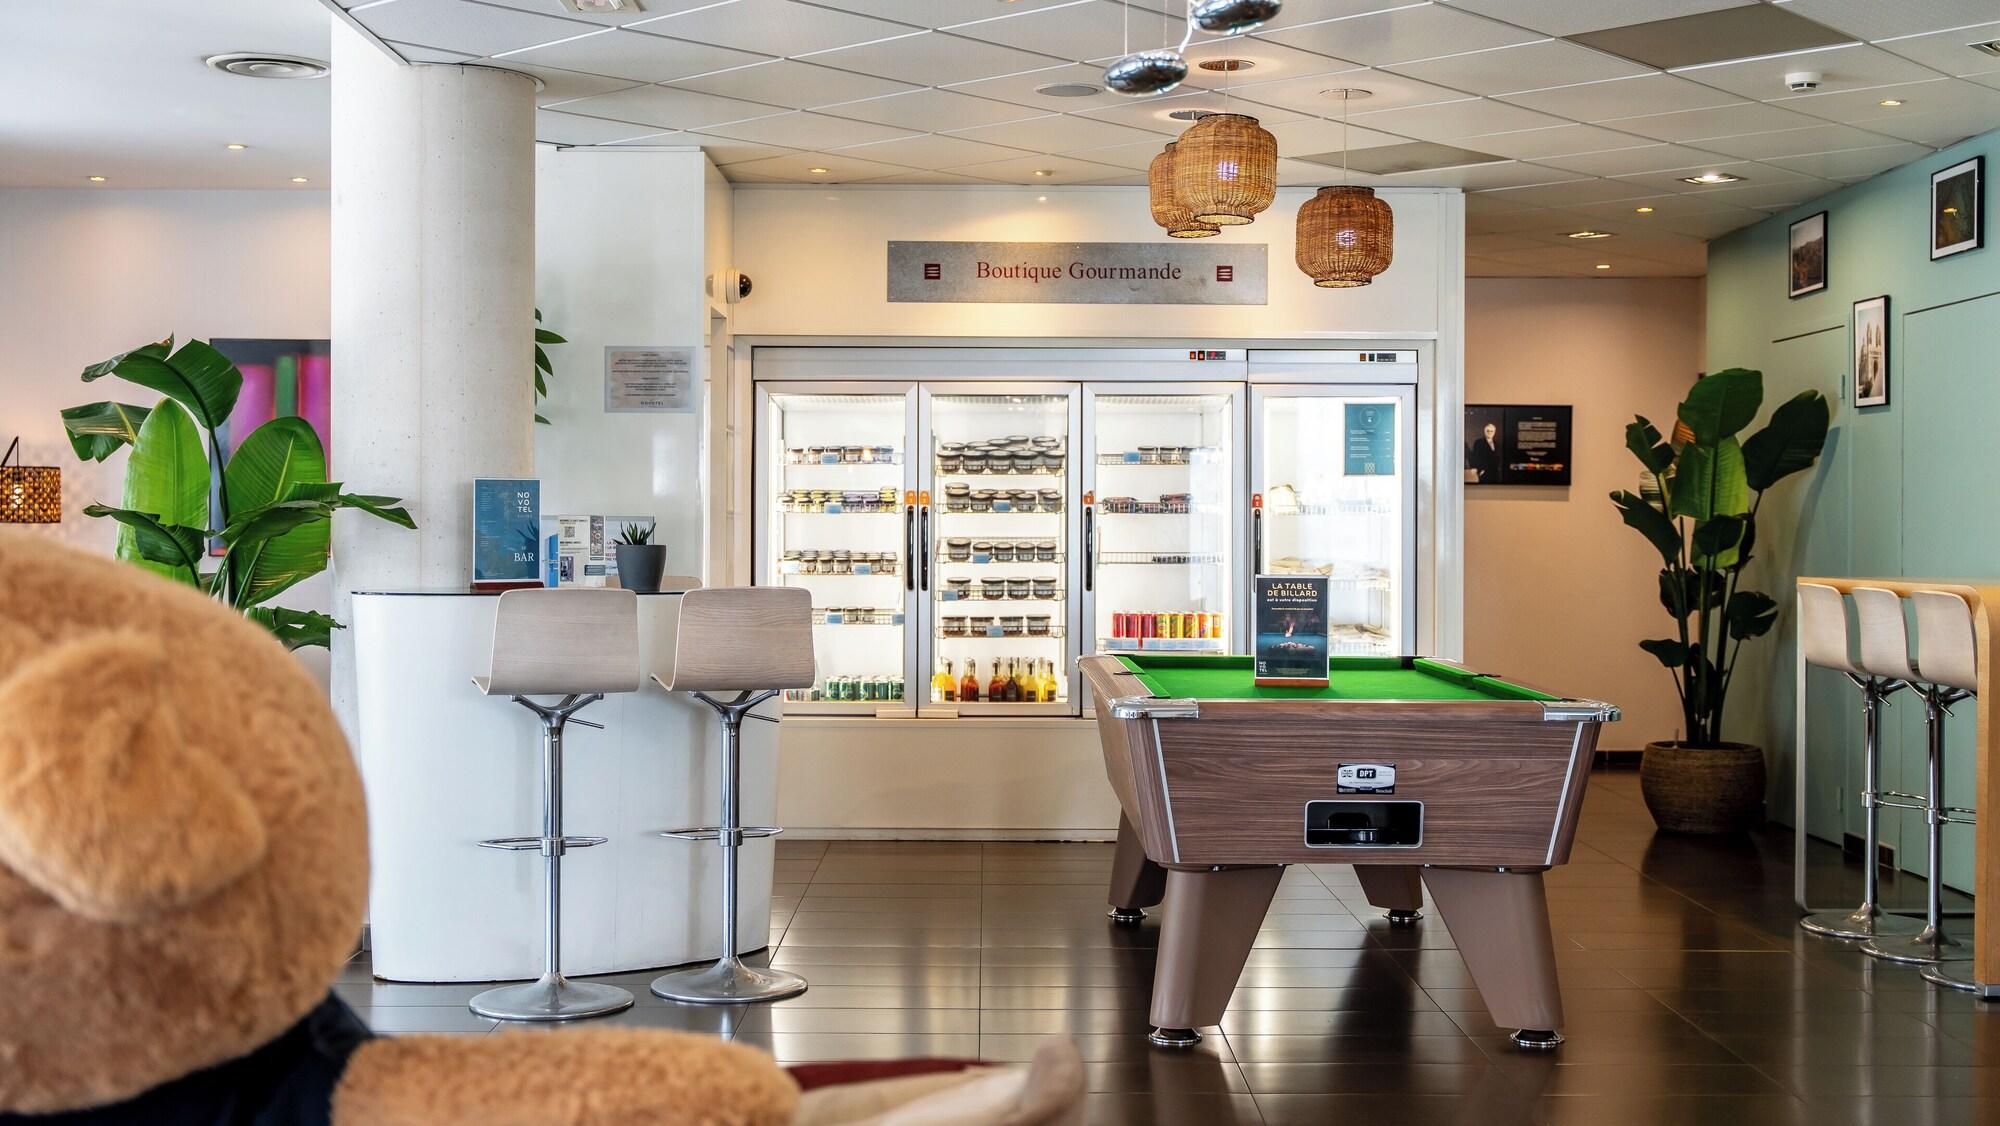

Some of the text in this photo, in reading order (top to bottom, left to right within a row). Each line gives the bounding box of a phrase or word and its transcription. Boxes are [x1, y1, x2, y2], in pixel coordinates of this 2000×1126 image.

[976, 261, 1181, 283] Boutique Gourmande
[514, 552, 534, 561] BAR
